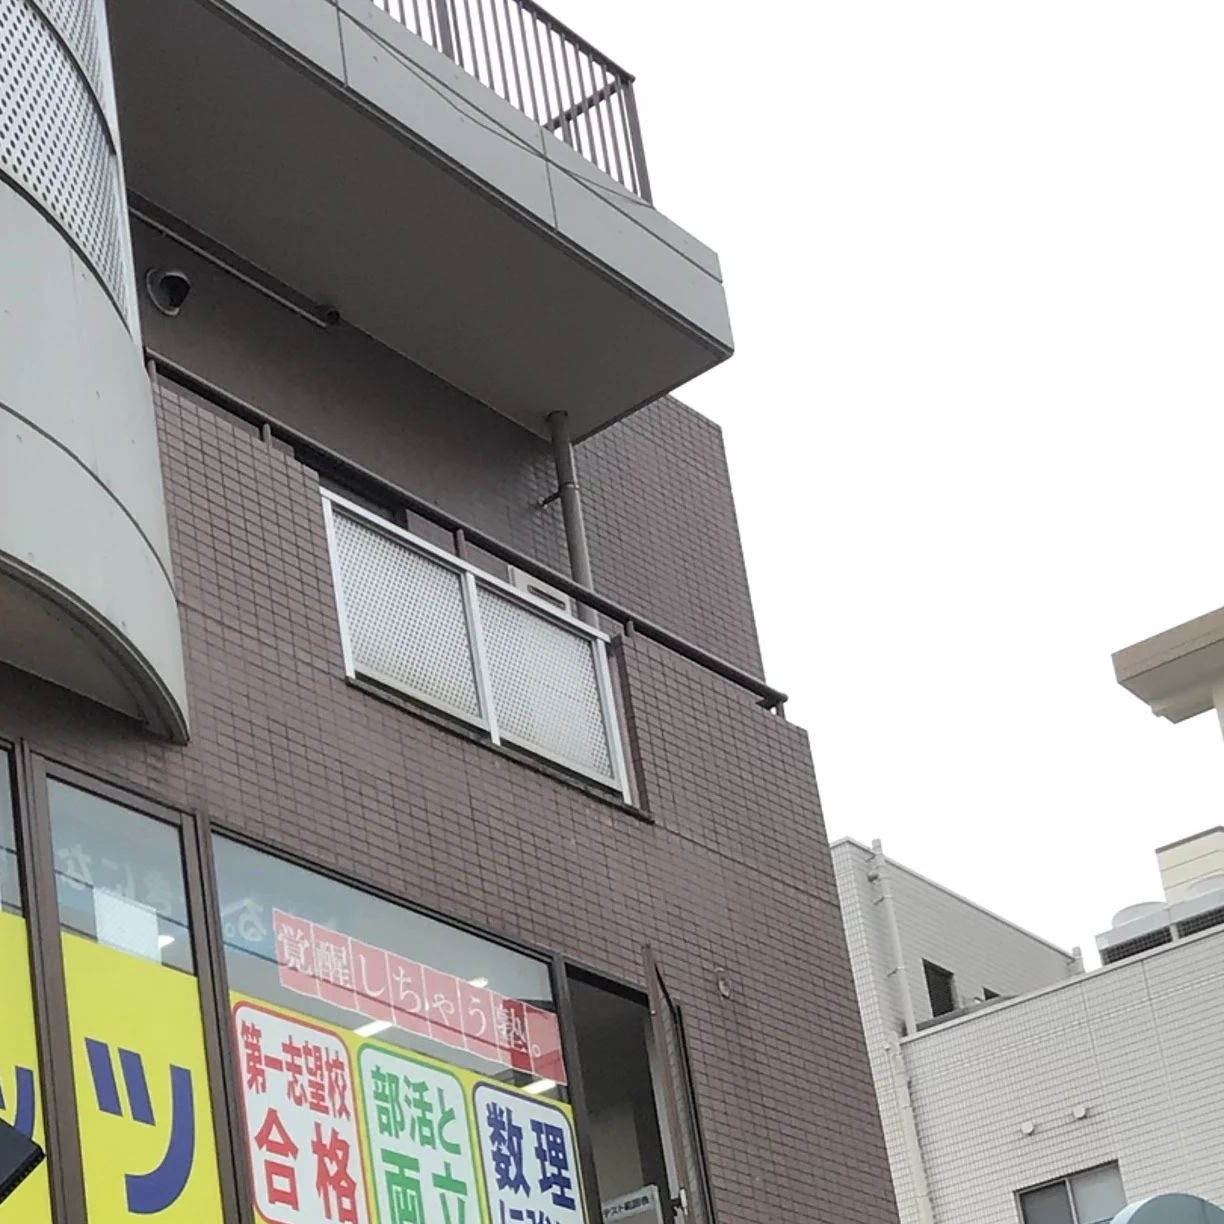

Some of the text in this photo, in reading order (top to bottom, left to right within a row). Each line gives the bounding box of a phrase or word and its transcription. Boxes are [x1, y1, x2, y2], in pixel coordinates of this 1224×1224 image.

[277, 926, 542, 1058] 覚醒しちゃう塾。
[240, 1019, 351, 1122] 第一志望校
[370, 1064, 462, 1156] 部活と
[485, 1101, 577, 1212] 数理
